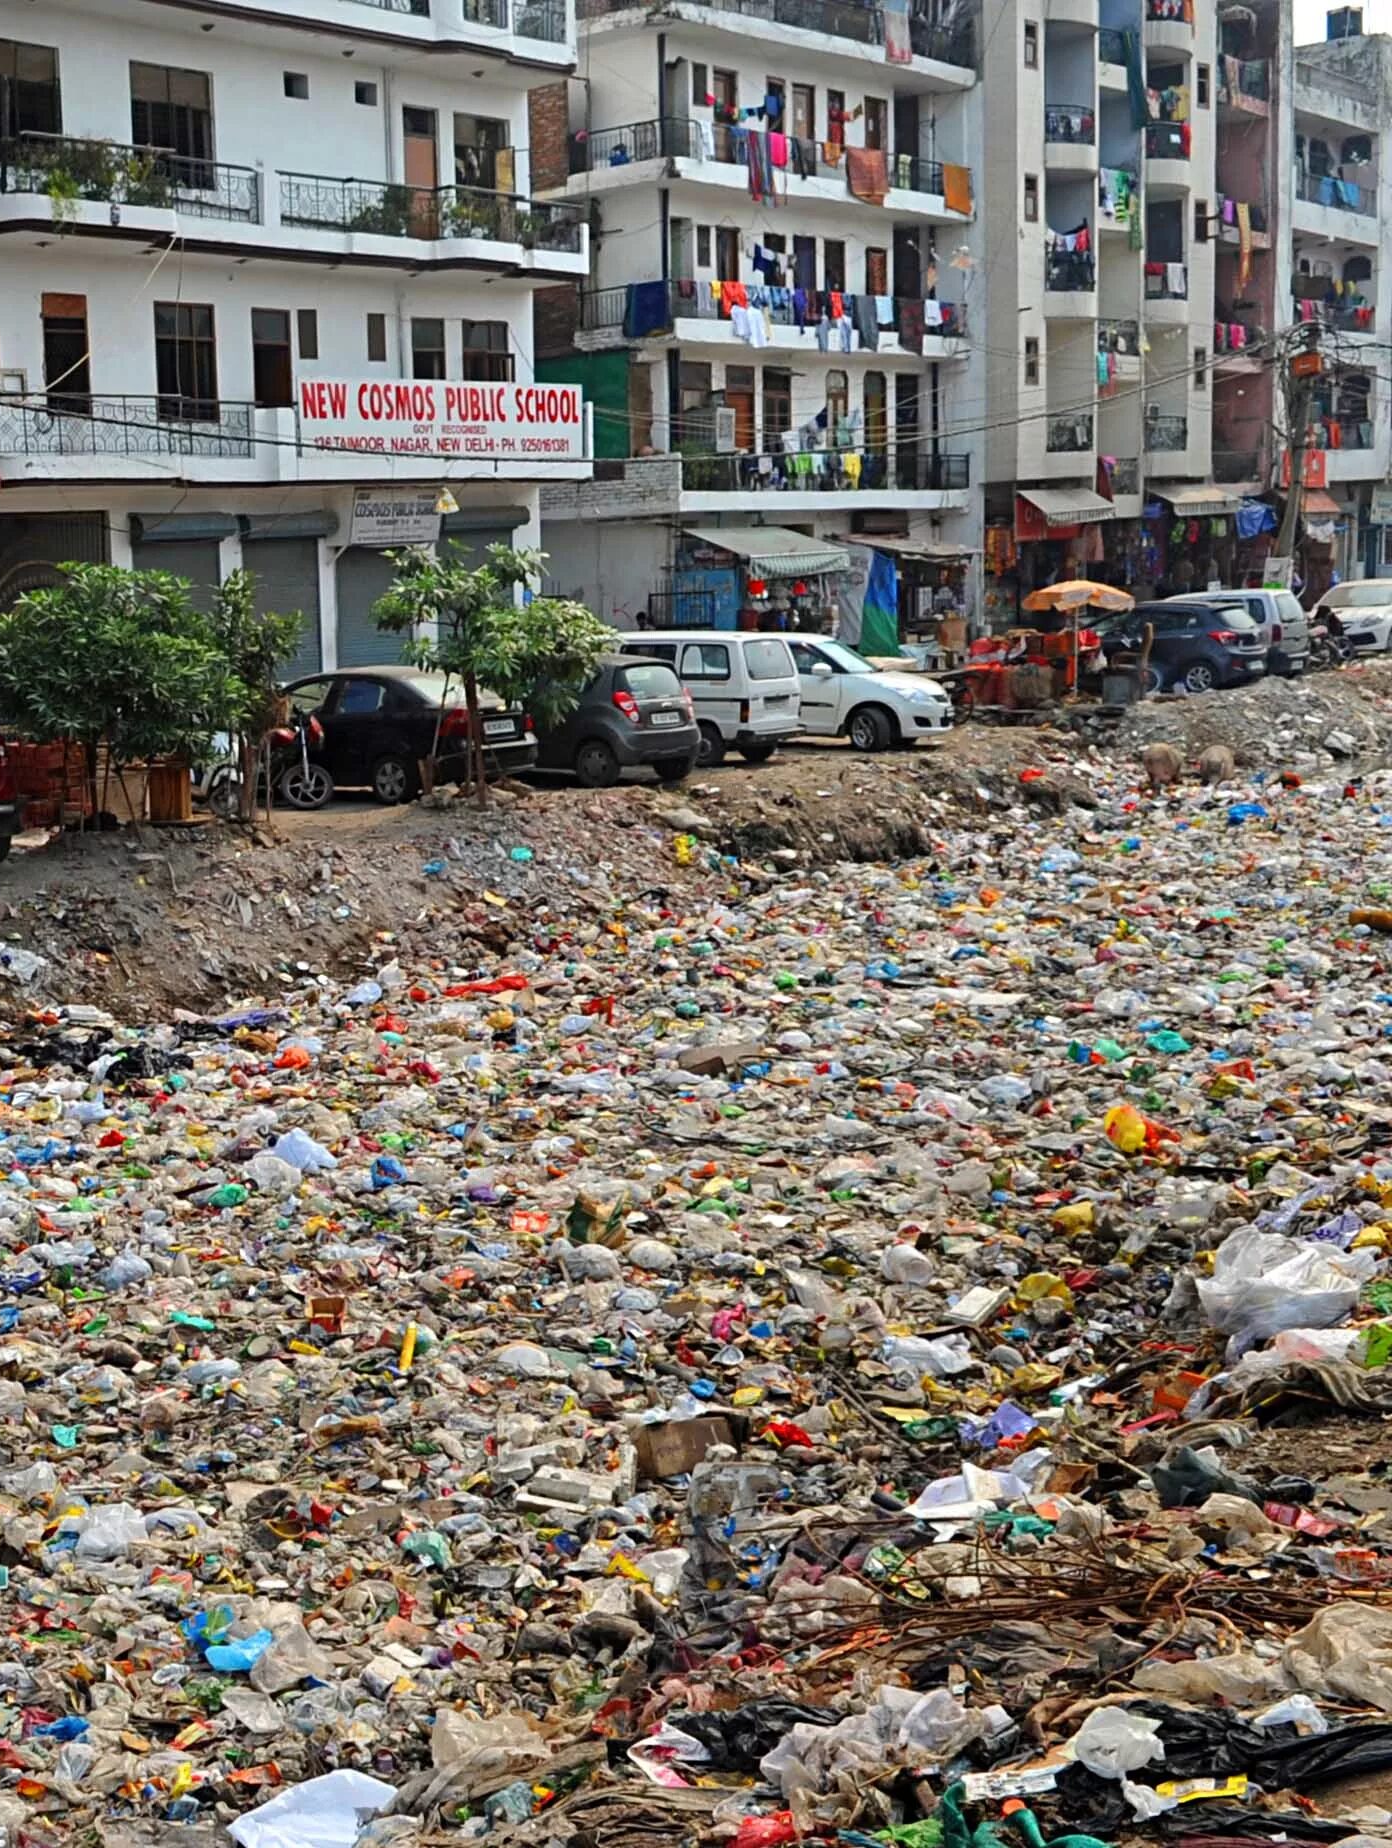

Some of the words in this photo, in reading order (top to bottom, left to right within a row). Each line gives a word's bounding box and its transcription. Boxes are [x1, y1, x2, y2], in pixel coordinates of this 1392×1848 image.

[301, 383, 347, 419] NEW
[358, 383, 436, 421] COSMOS
[446, 387, 507, 422] PUBLIC
[516, 389, 579, 423] SCHOOL
[413, 424, 434, 435] GOVT
[441, 426, 487, 435] RECOGNISED
[436, 439, 460, 452] NEW
[465, 439, 494, 452] DELHI
